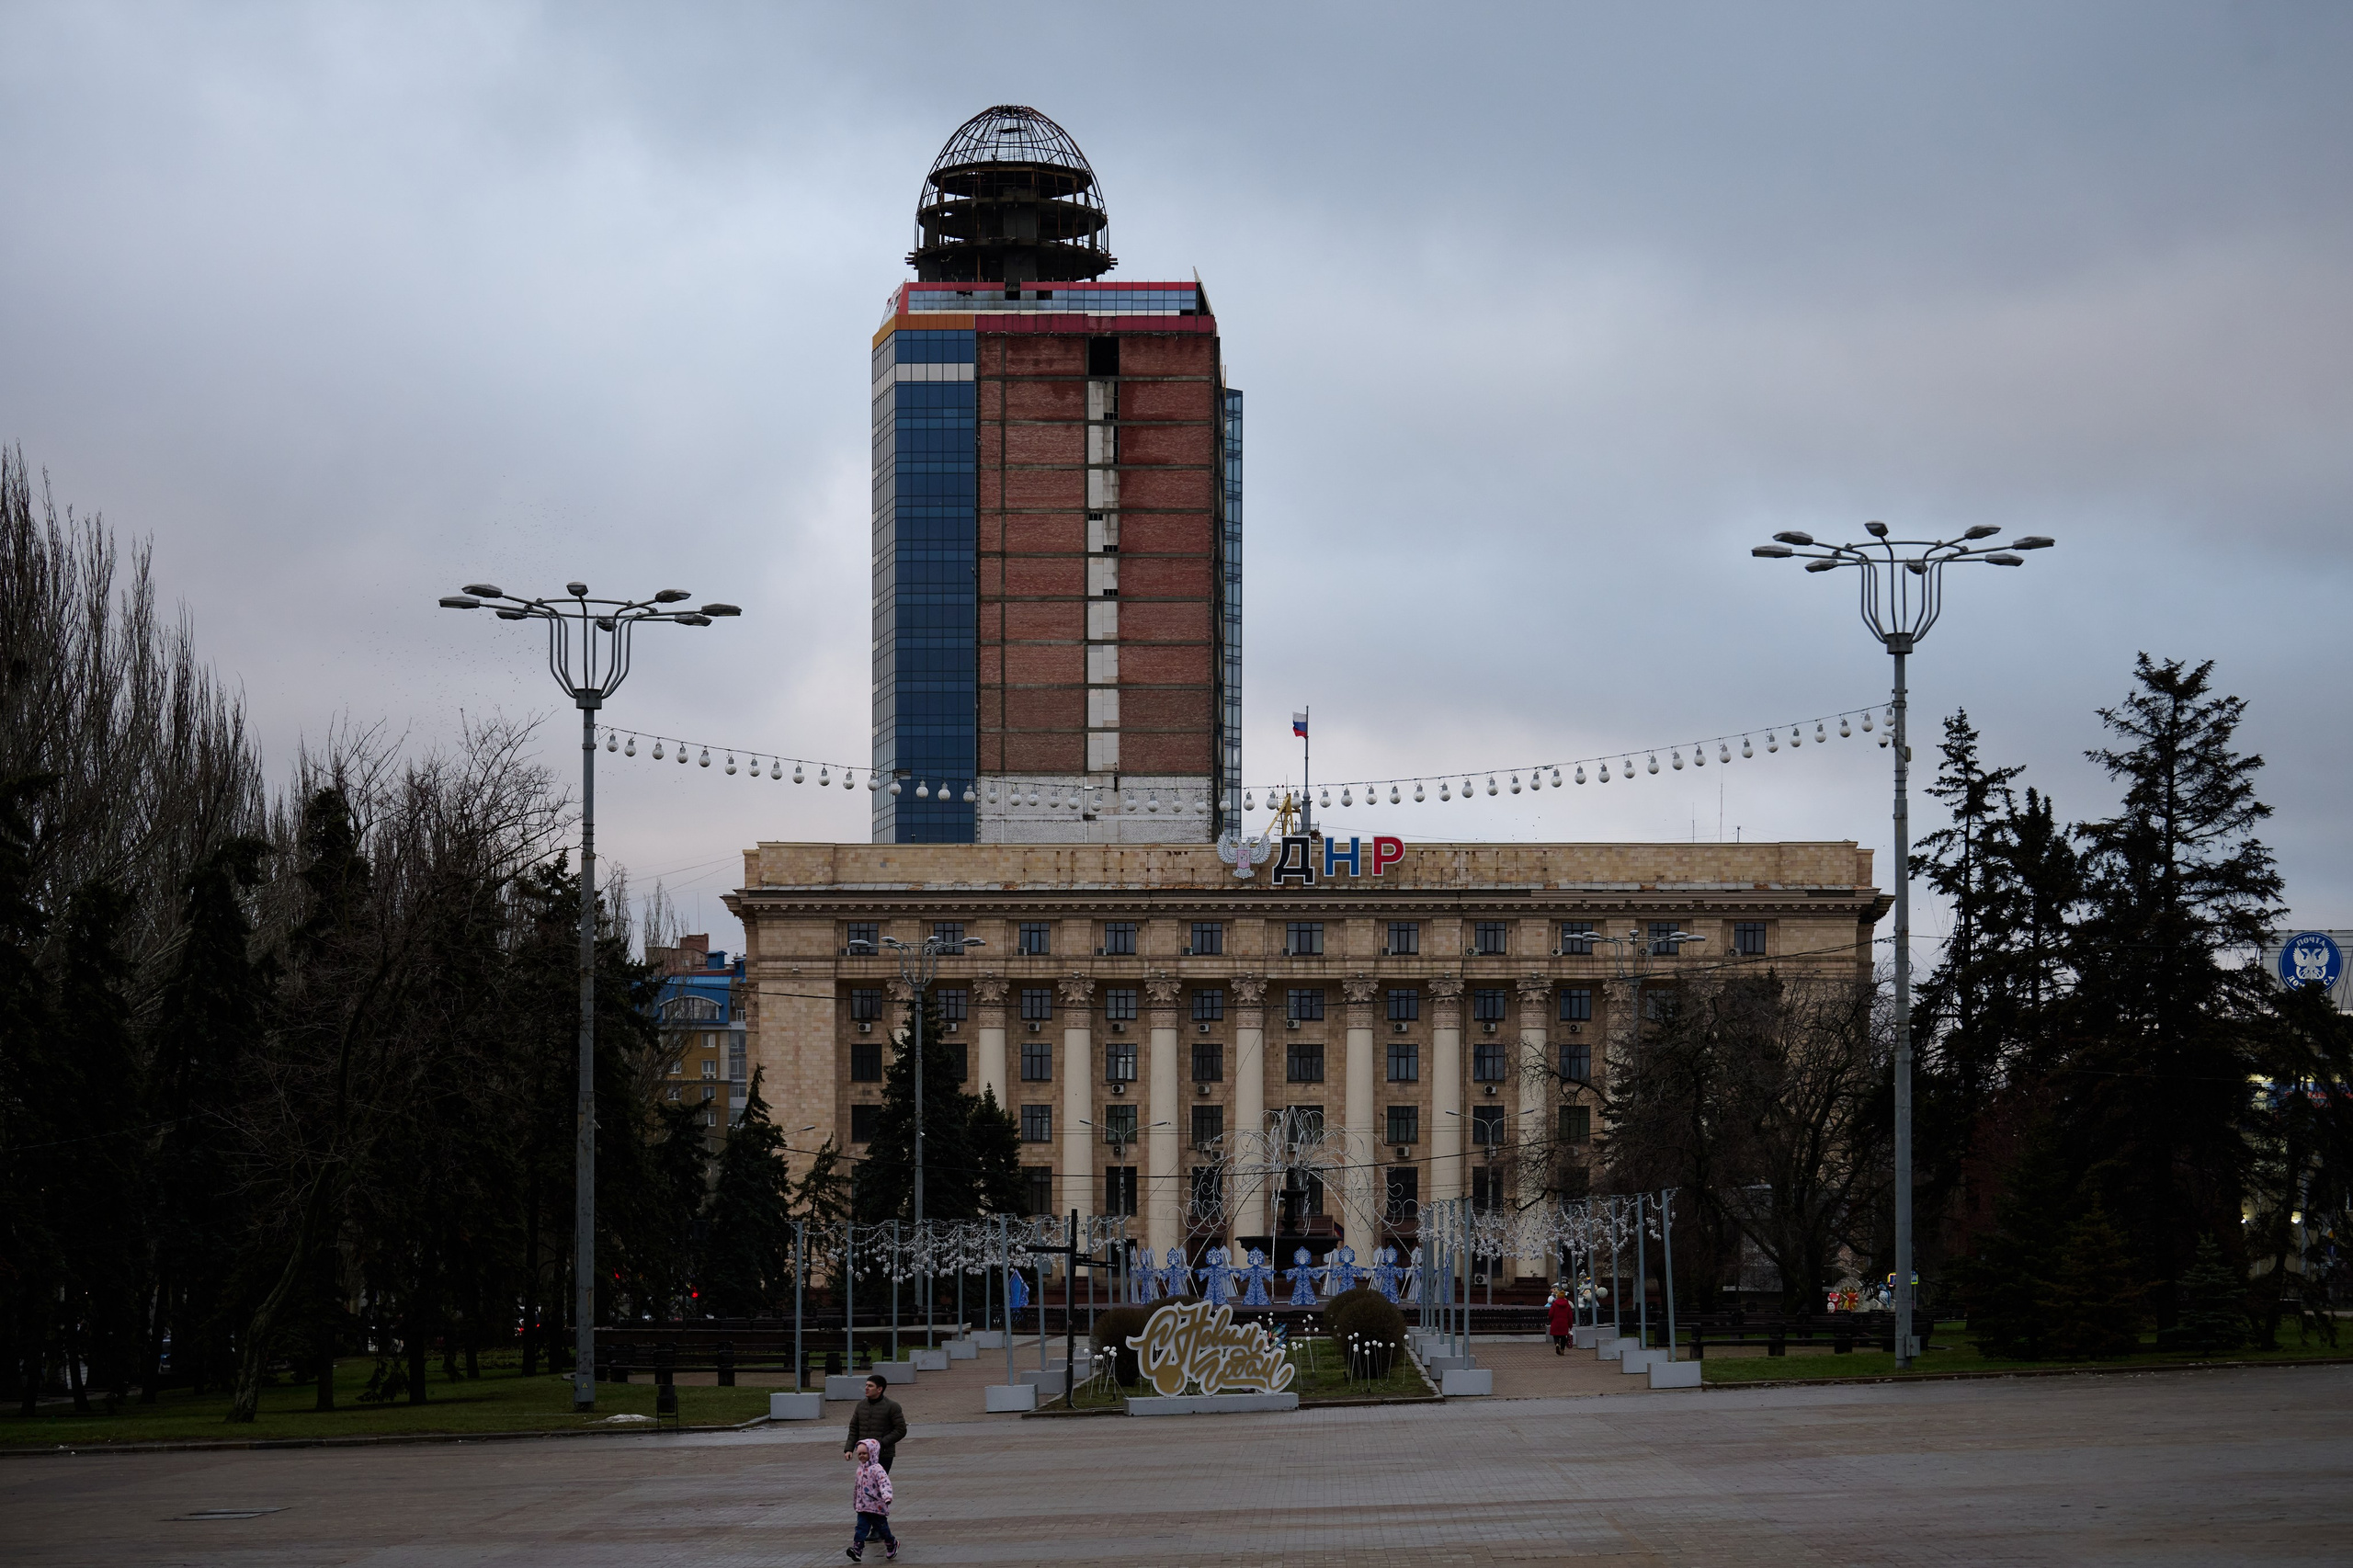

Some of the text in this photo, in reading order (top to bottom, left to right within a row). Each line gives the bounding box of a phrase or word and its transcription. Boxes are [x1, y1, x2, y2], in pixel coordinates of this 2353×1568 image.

[1272, 835, 1405, 885] ДНР
[2296, 937, 2325, 947] ПОЧТА
[1175, 1303, 1265, 1373] Новым
